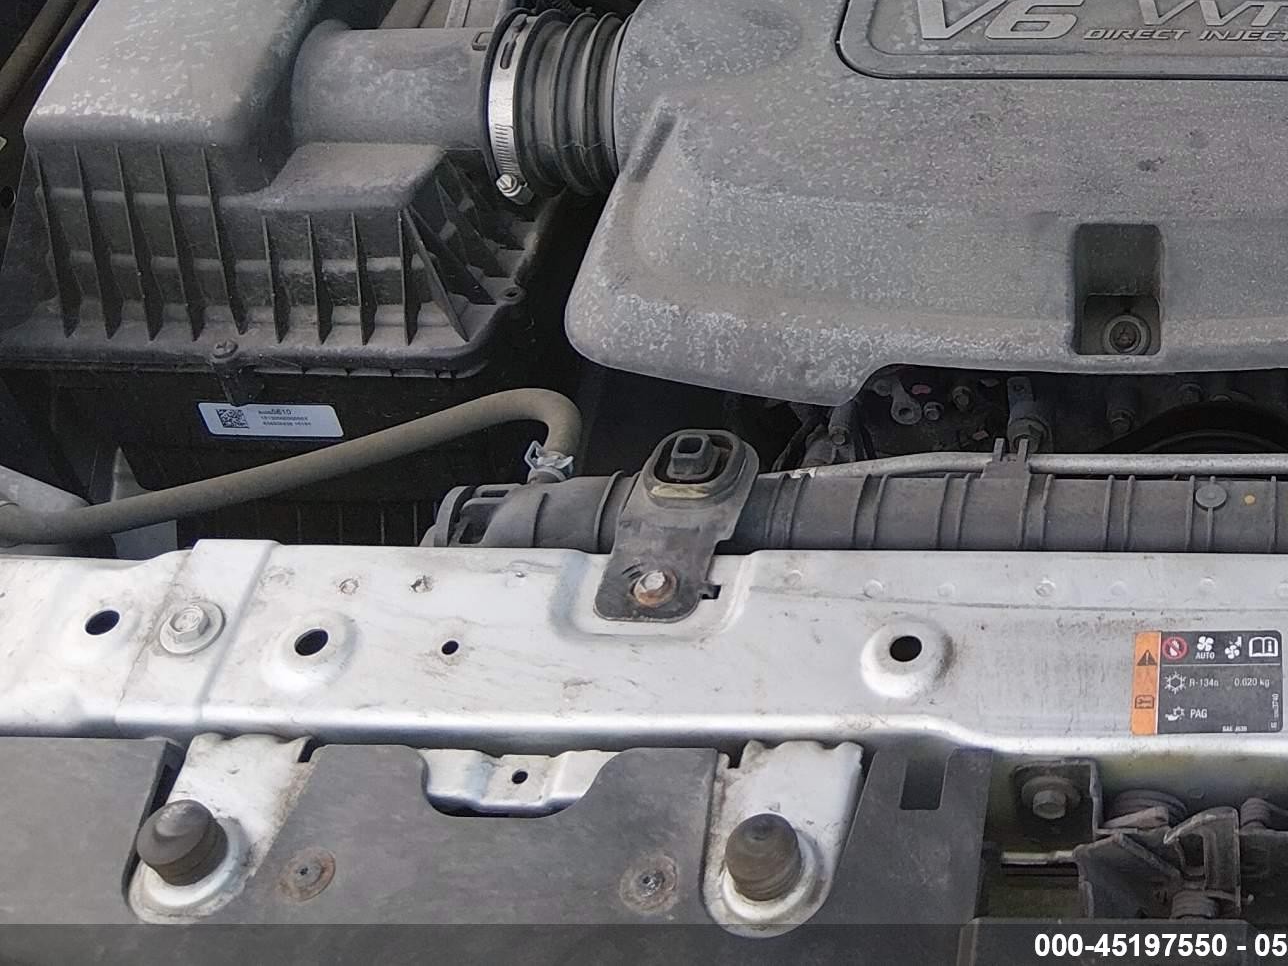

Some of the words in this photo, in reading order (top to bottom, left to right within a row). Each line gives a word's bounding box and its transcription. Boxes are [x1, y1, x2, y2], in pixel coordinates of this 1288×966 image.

[1083, 28, 1189, 41] DIRECT
[1195, 652, 1215, 660] AUTO
[1188, 677, 1219, 687] R-134a
[1234, 677, 1258, 686] 0.620
[1259, 678, 1270, 689] kg
[1190, 708, 1208, 719] PAG
